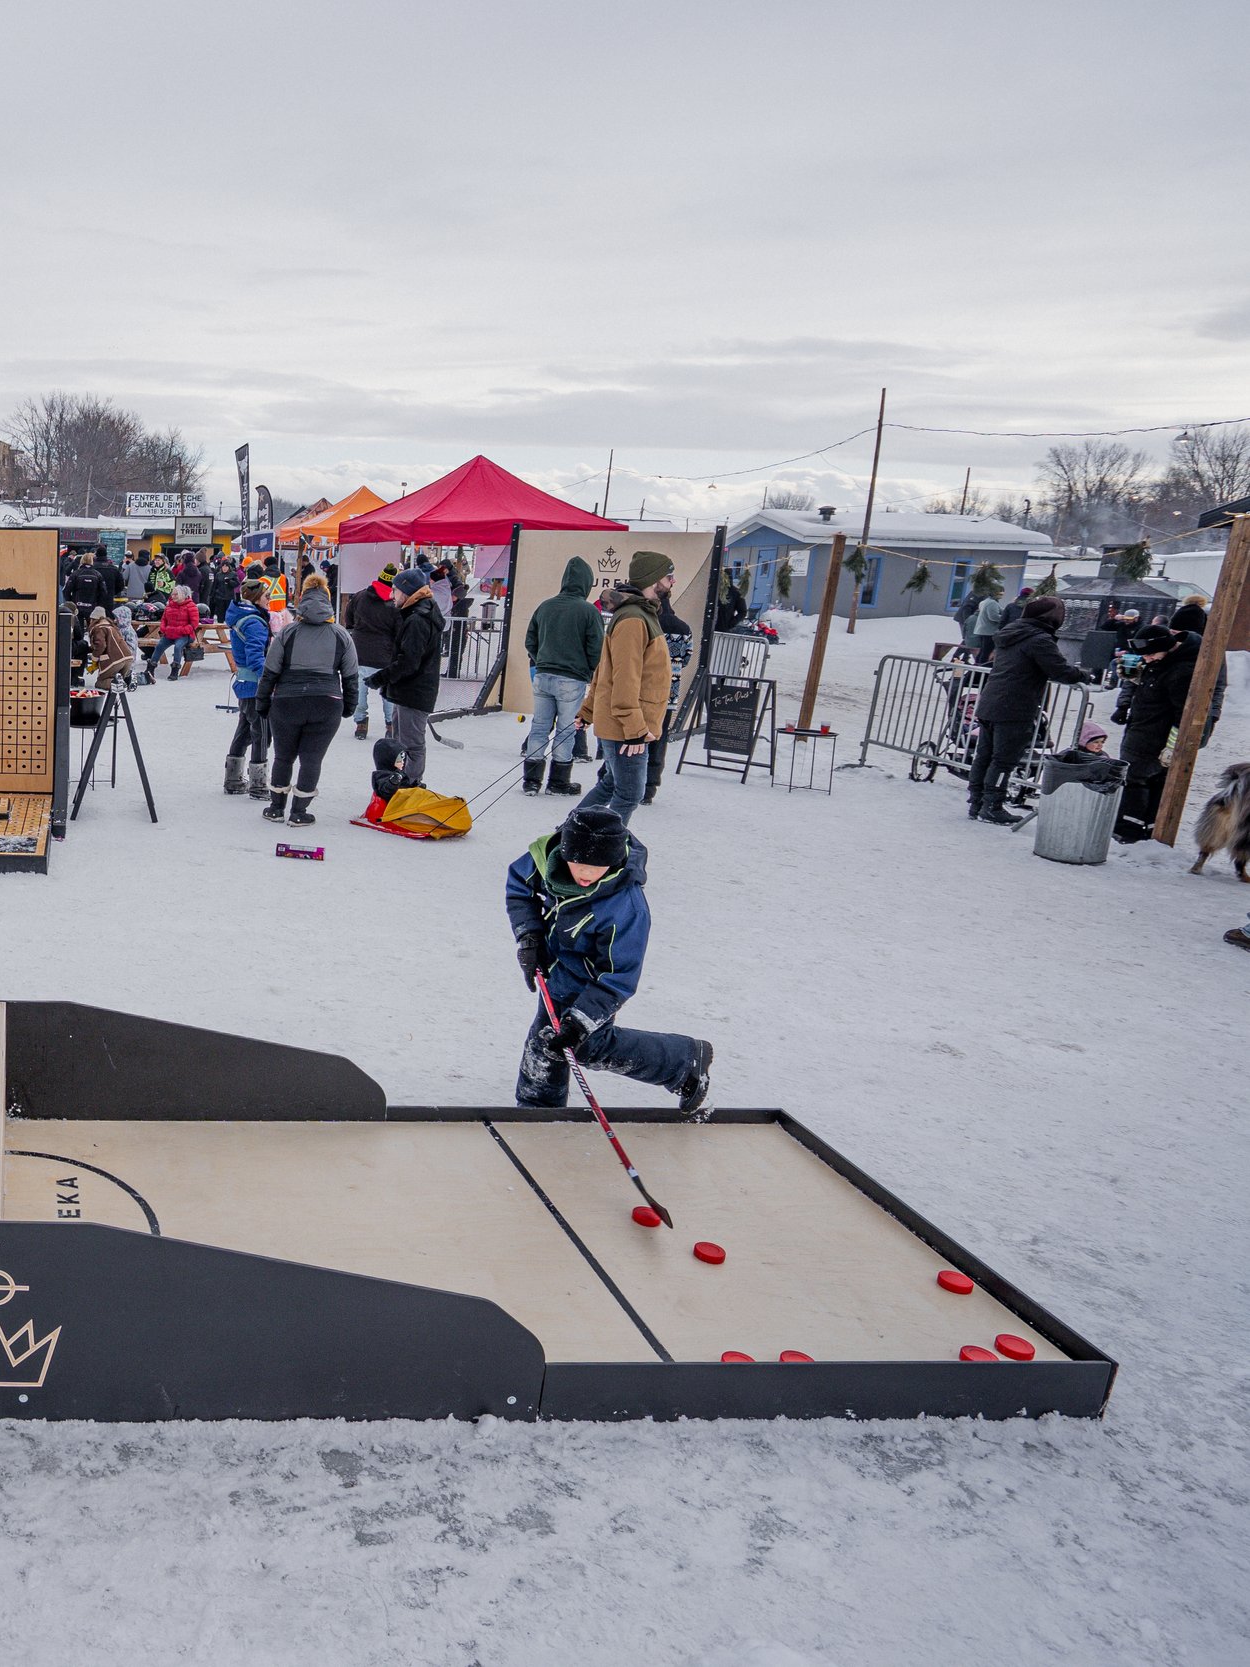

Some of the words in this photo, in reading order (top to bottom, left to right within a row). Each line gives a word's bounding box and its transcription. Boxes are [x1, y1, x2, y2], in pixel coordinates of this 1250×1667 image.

[8, 613, 15, 624] 8
[22, 613, 29, 624] 9
[35, 613, 47, 625] 10
[56, 1176, 81, 1218] EKA
